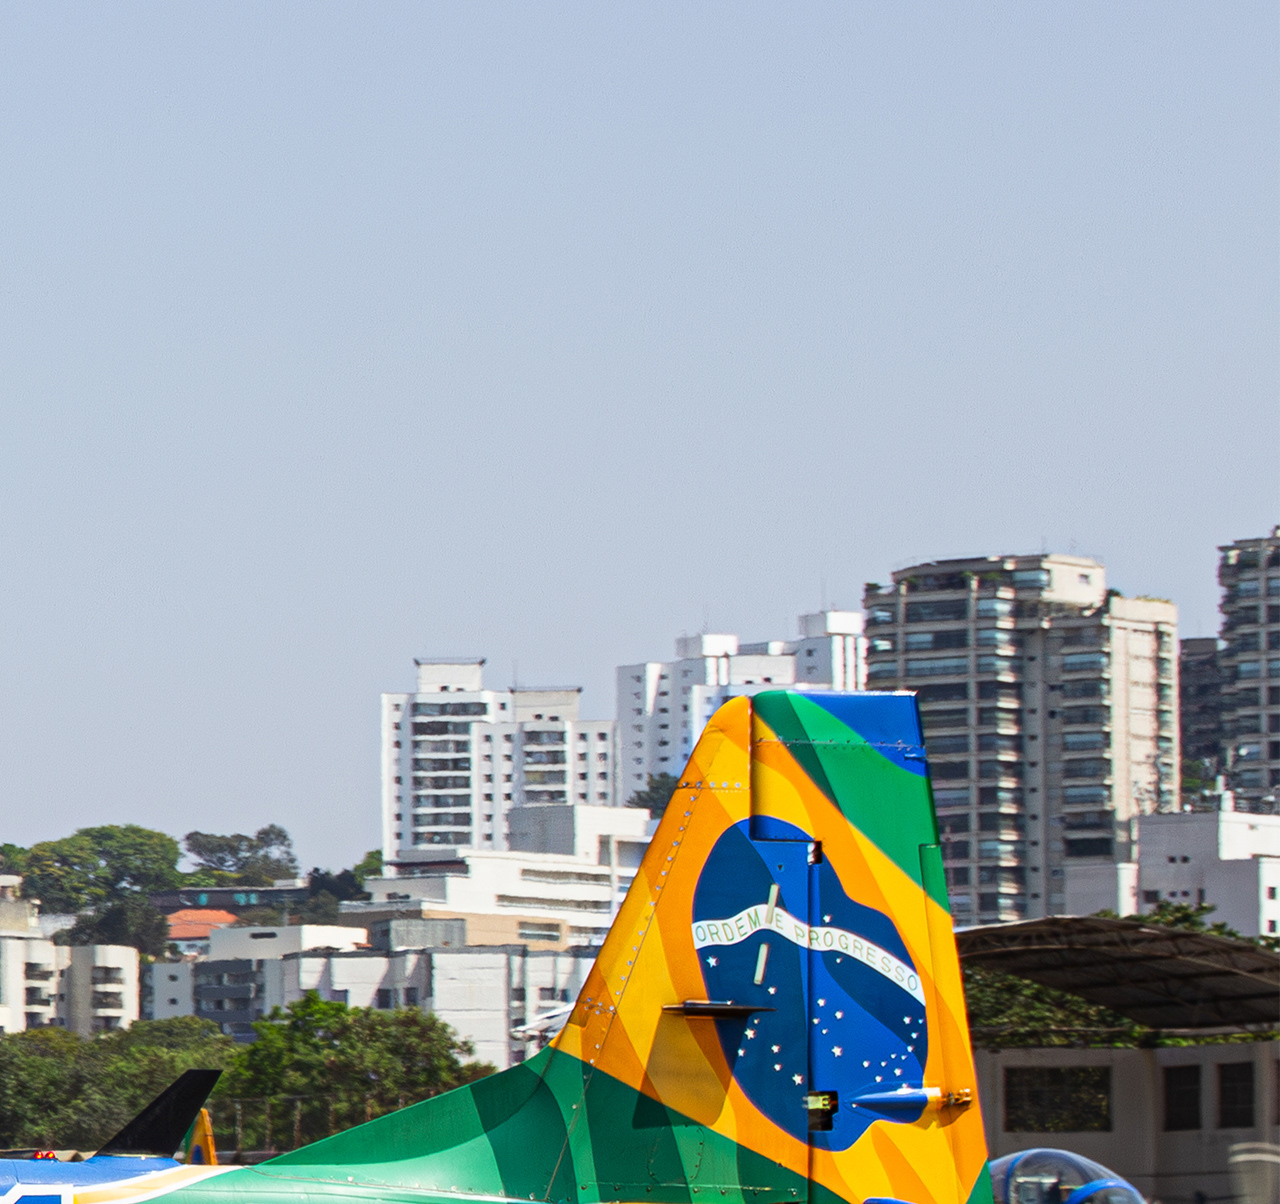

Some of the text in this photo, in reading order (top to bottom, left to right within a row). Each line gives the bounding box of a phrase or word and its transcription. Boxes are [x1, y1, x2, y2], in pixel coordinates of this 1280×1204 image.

[695, 908, 919, 992] ORDEM E PROGRESSO
